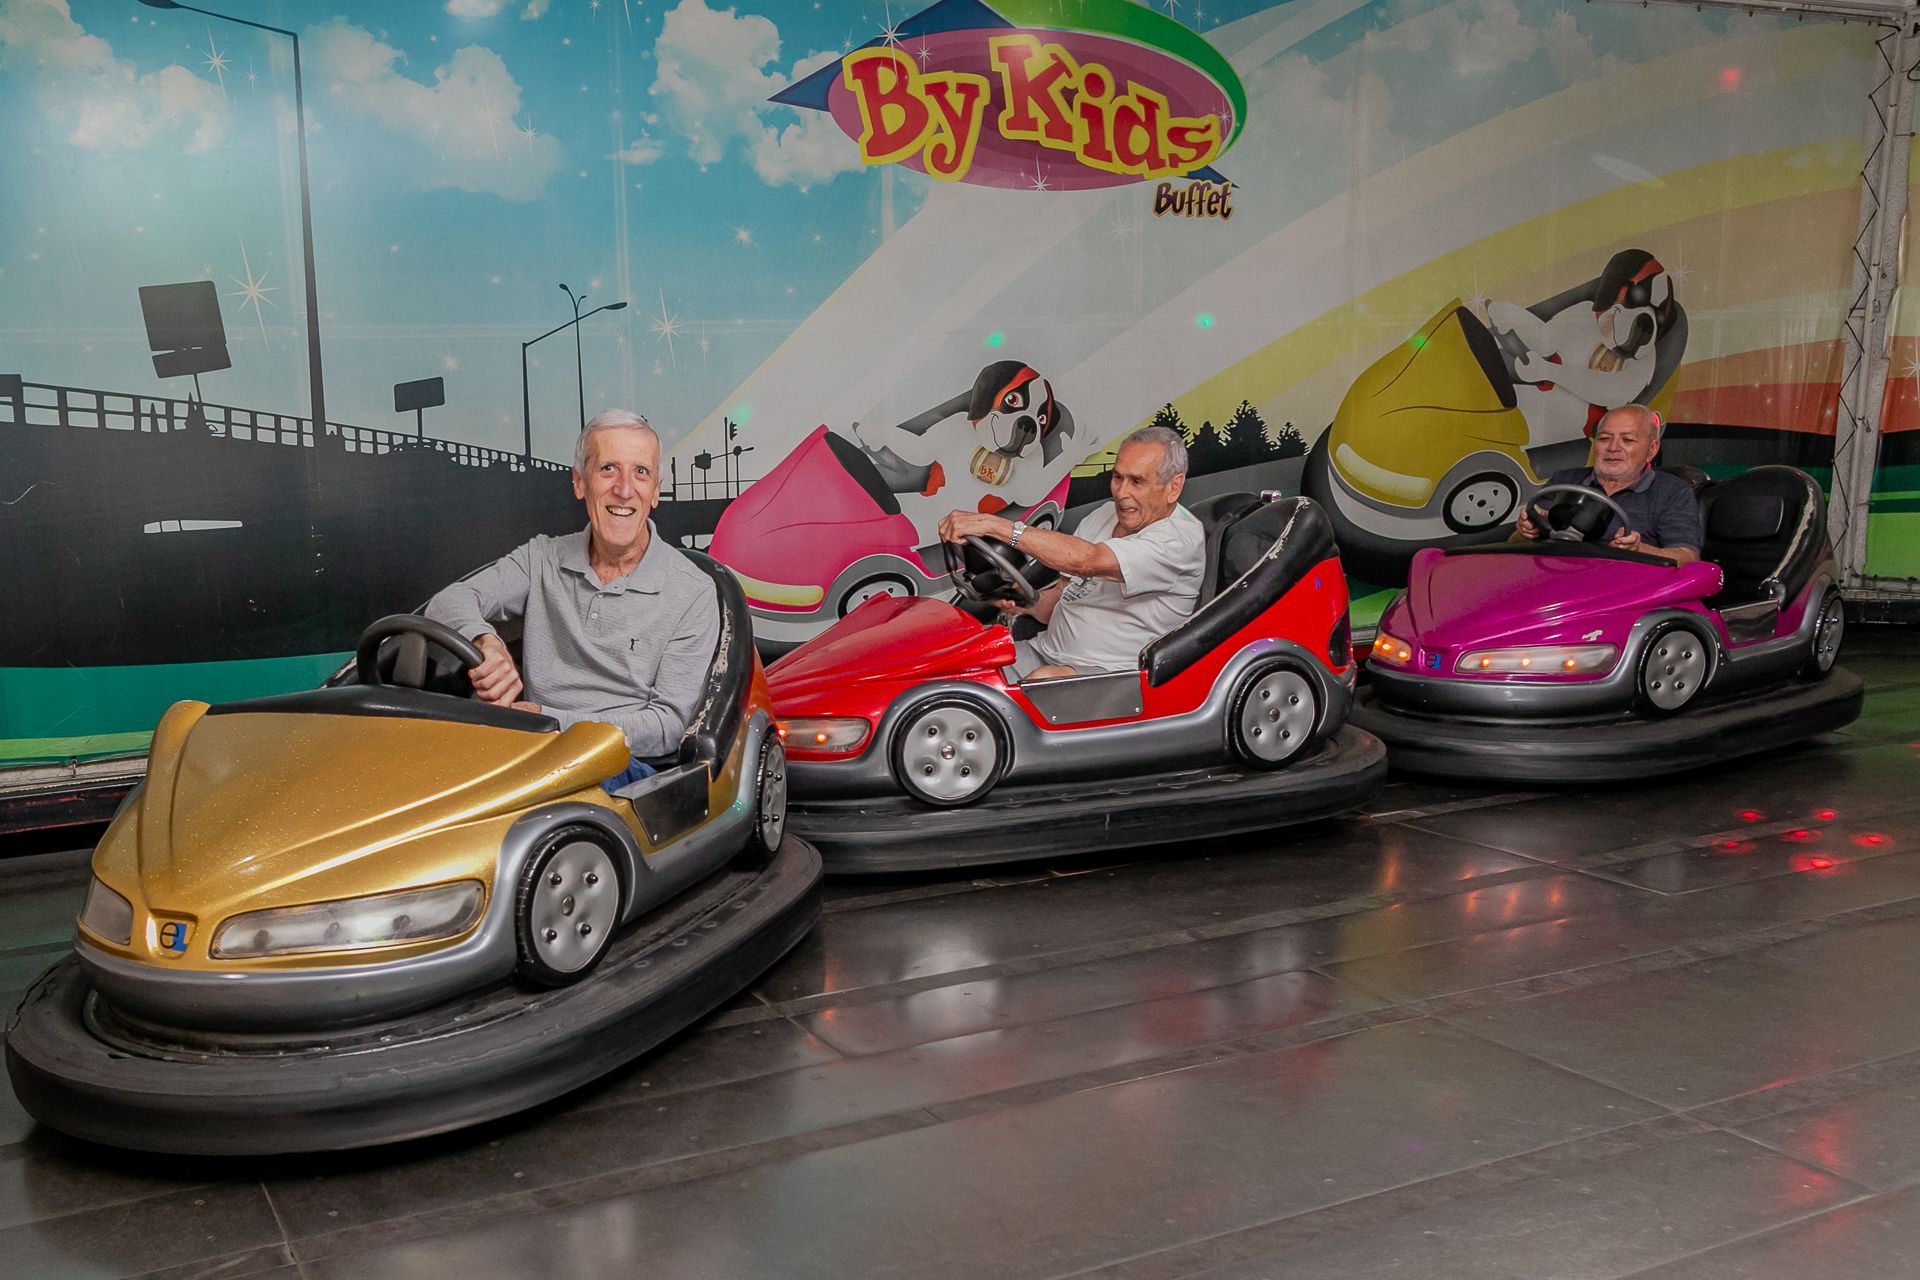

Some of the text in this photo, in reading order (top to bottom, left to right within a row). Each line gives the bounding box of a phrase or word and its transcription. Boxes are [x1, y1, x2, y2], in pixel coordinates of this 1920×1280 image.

[847, 40, 1217, 178] By Kids
[1153, 180, 1231, 219] Buffet
